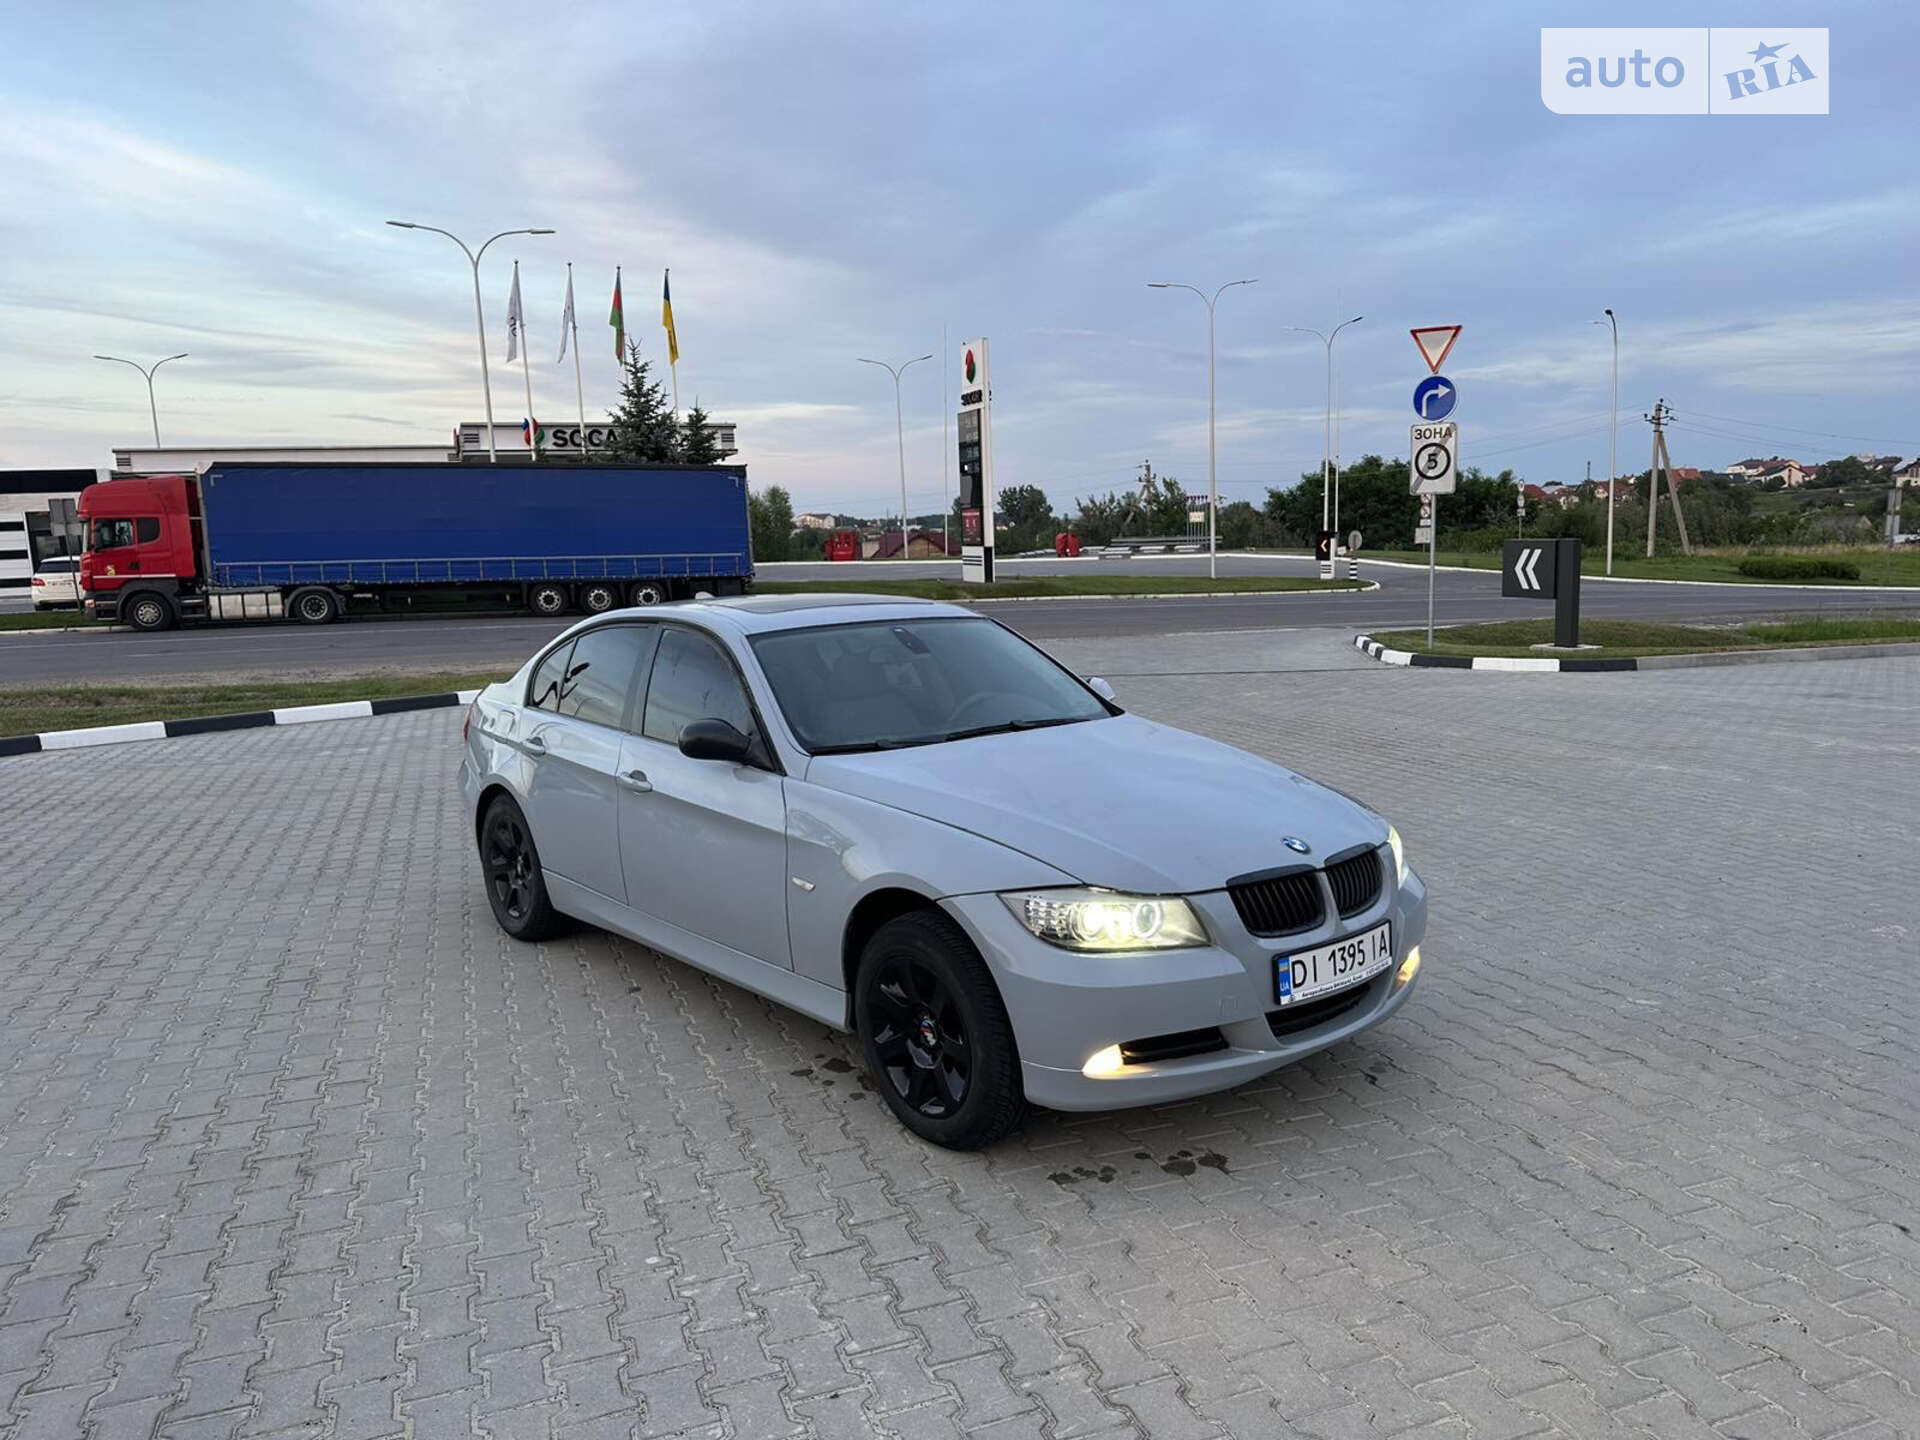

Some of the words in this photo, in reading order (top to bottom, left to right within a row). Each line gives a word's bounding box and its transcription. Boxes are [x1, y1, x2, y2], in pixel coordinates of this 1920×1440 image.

[552, 428, 624, 448] SOCA
[1414, 426, 1453, 440] ЗОНА
[1427, 452, 1438, 470] 5
[1291, 954, 1317, 989] DI
[1328, 939, 1366, 978] 1395
[1372, 930, 1388, 961] IA
[1279, 980, 1291, 993] UA
